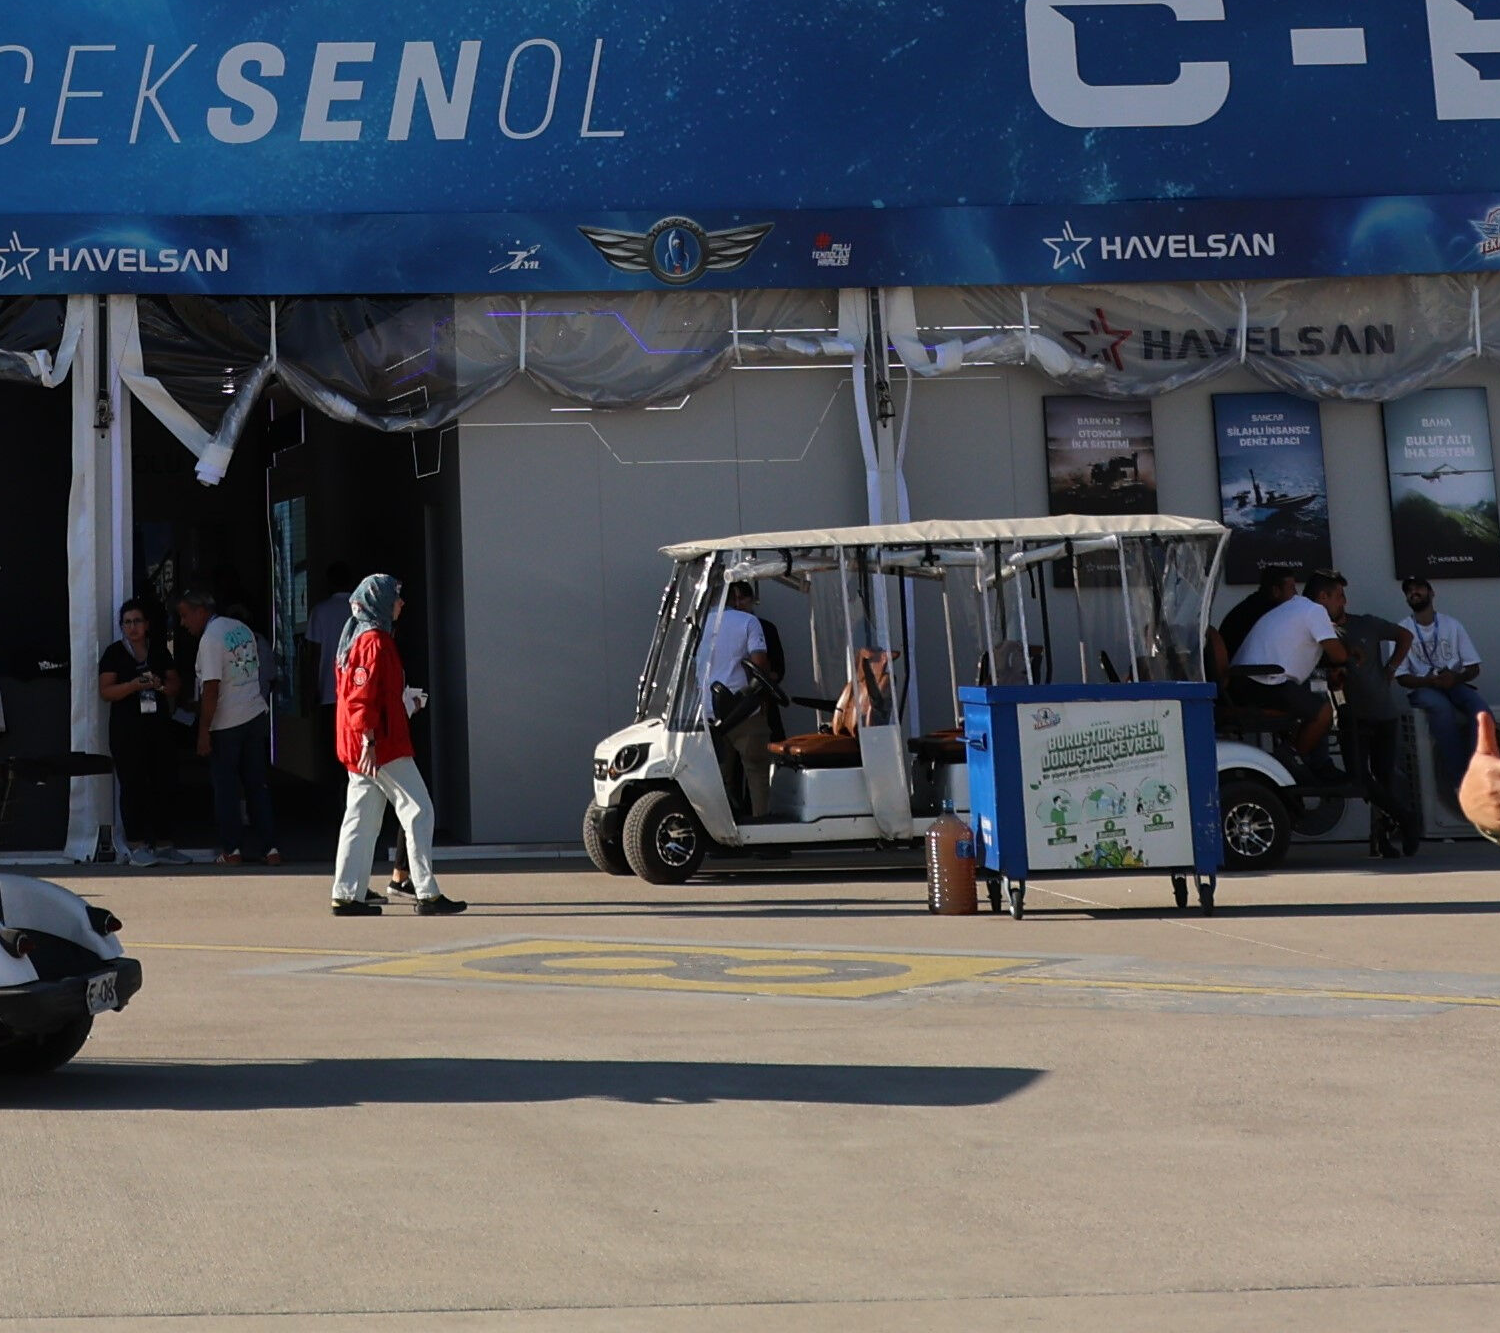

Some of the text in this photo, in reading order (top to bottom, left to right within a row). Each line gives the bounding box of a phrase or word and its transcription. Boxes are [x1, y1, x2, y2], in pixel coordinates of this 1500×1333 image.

[1100, 233, 1275, 260] HAVELSAN
[48, 247, 228, 272] HAVELSAN
[1142, 322, 1396, 361] HAVELSAN
[1421, 418, 1452, 427] BAHA
[1405, 436, 1444, 445] BULUT
